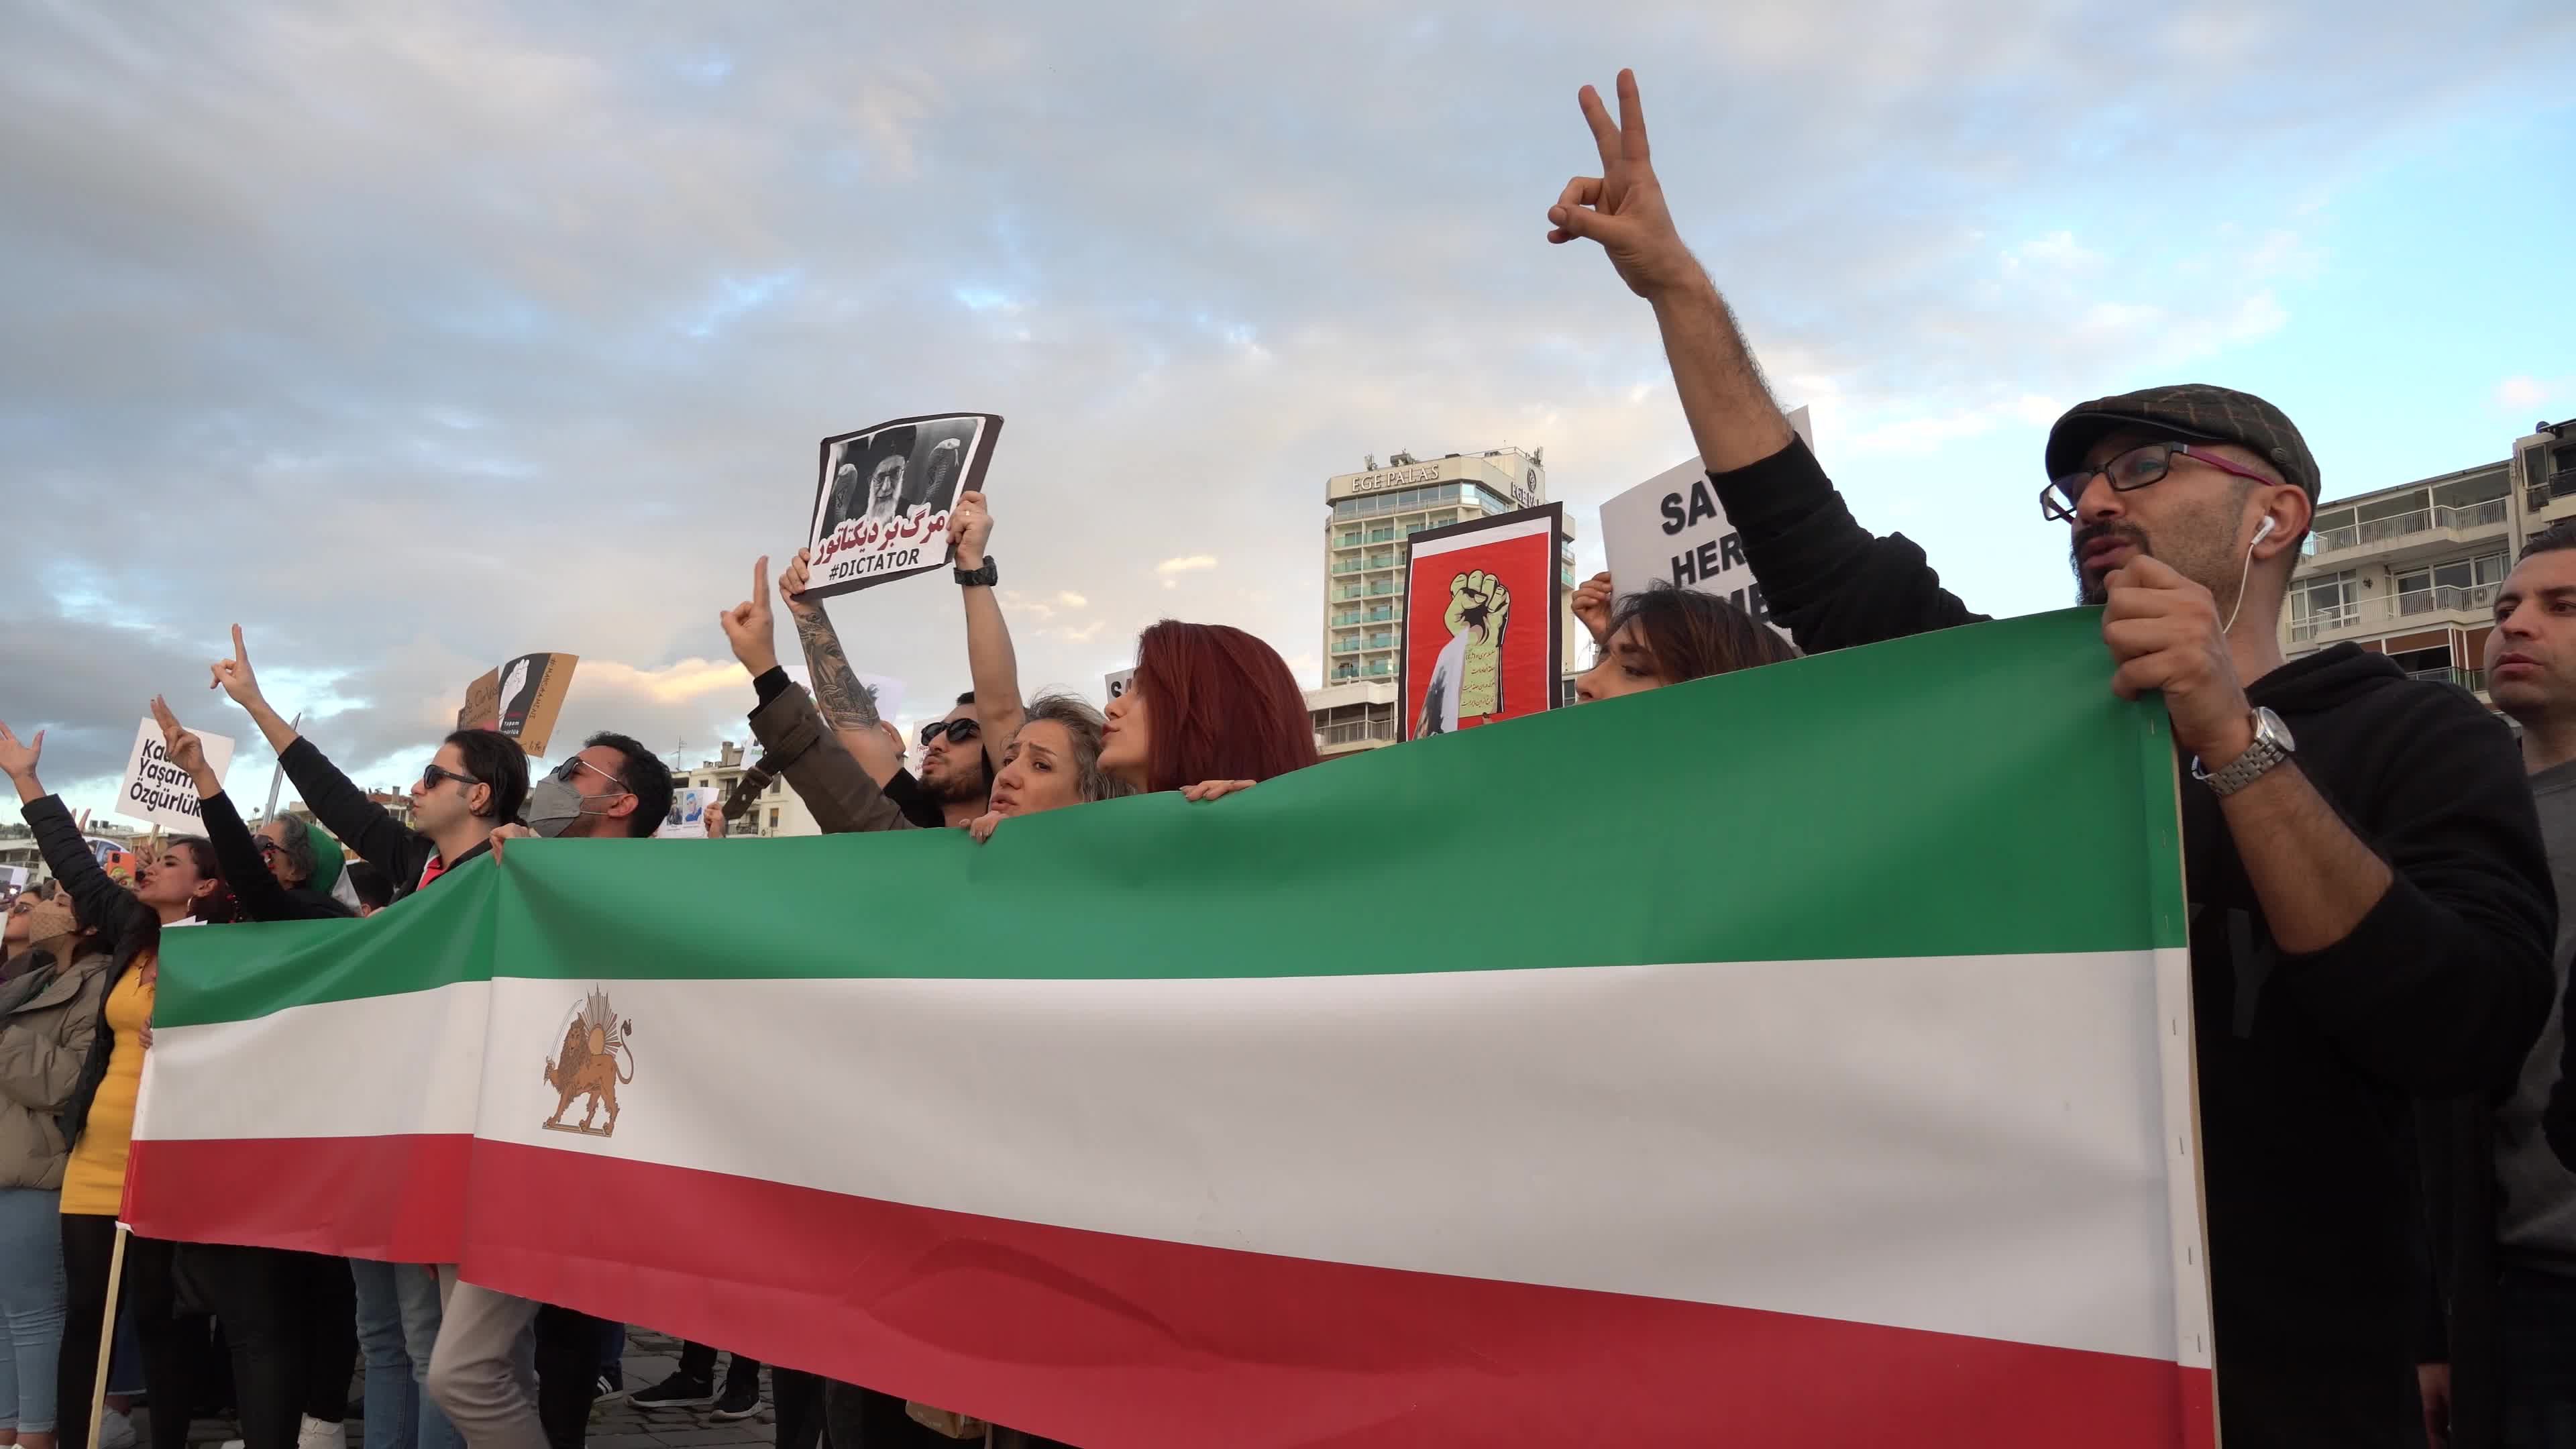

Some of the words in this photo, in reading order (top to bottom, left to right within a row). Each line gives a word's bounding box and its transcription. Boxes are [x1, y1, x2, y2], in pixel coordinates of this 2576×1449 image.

[1352, 474, 1381, 492] EGE
[1387, 464, 1439, 487] PALAS
[1660, 480, 1717, 535] SA
[813, 521, 878, 566] دیکتاتور
[877, 521, 899, 551] بر
[900, 508, 945, 544] مرگ
[829, 548, 920, 580] #DICTATOR
[1671, 531, 1746, 589] HER
[139, 757, 194, 789] Yaşam
[130, 777, 201, 817] Özgürlük
